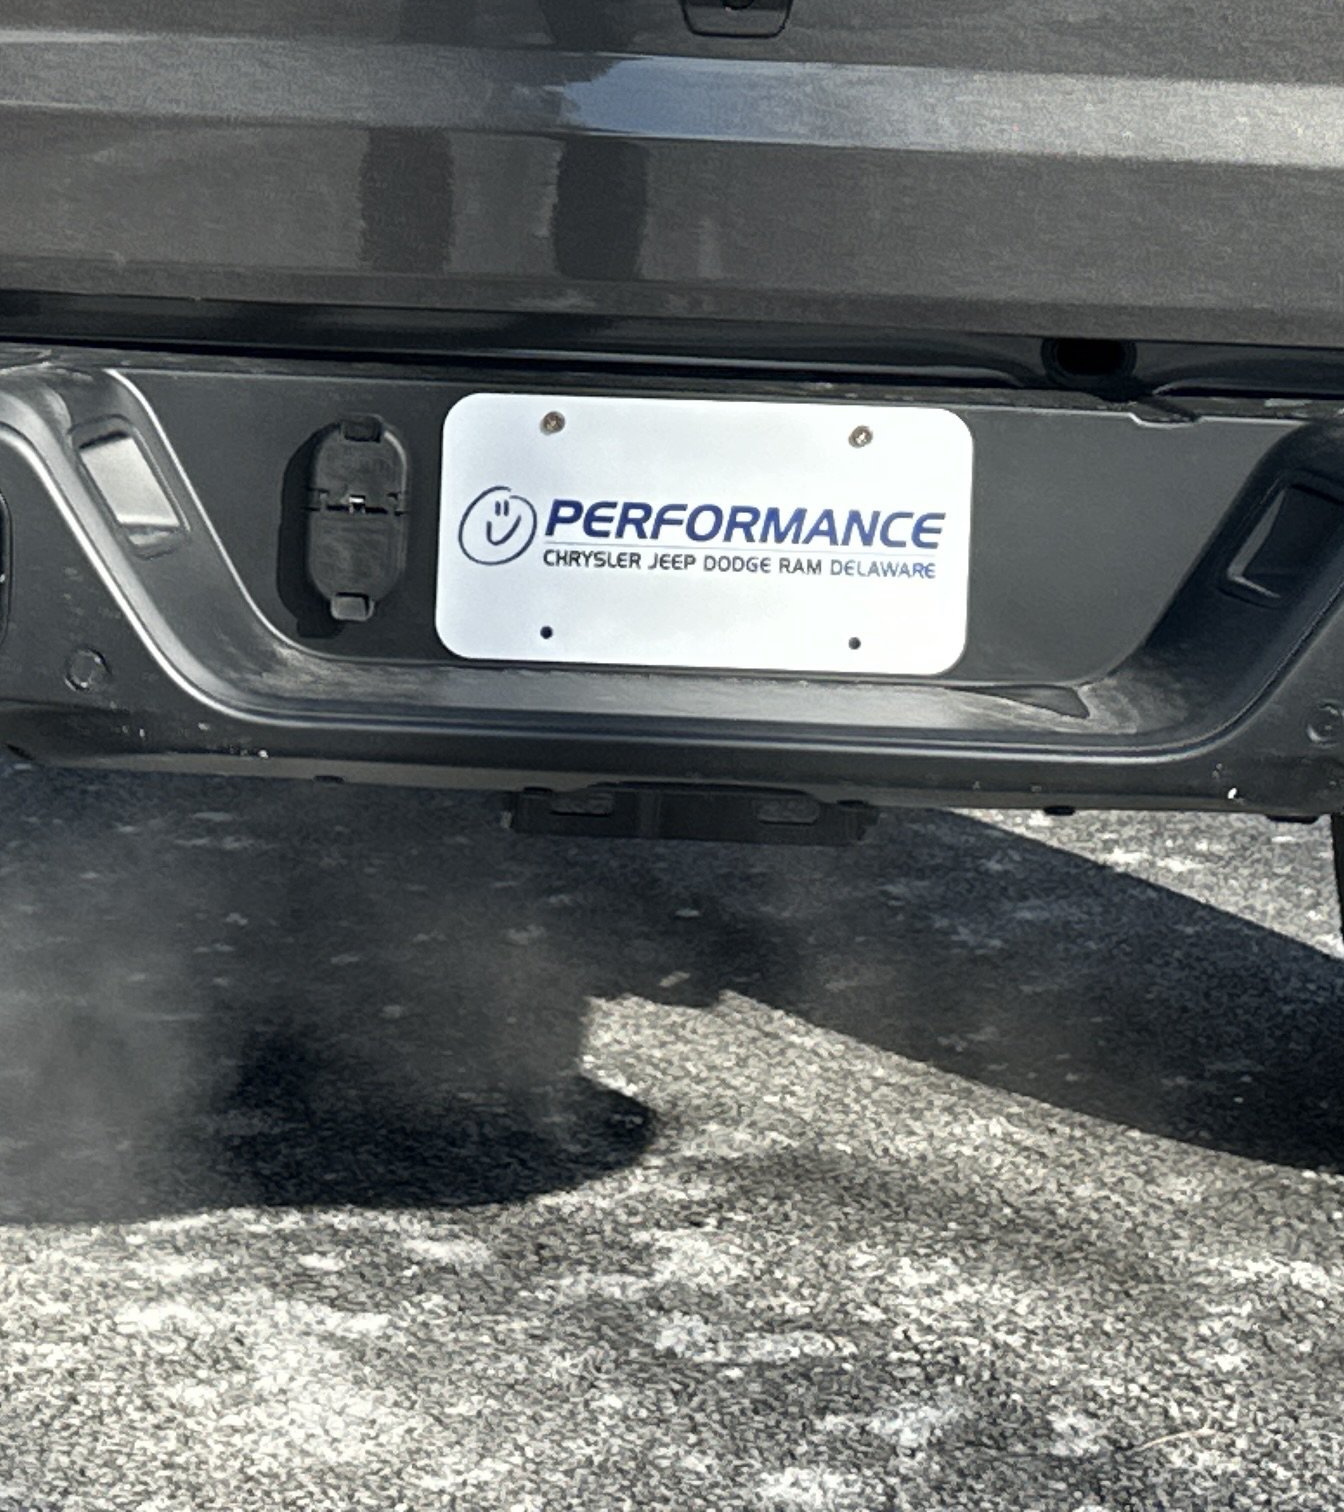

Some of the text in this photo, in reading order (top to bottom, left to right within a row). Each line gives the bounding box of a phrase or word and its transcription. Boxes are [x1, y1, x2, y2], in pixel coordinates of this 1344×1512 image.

[545, 498, 947, 549] PERFORMANCE
[543, 549, 936, 579] CHRYSLER JEEP DODGE RAM DELAWARE
